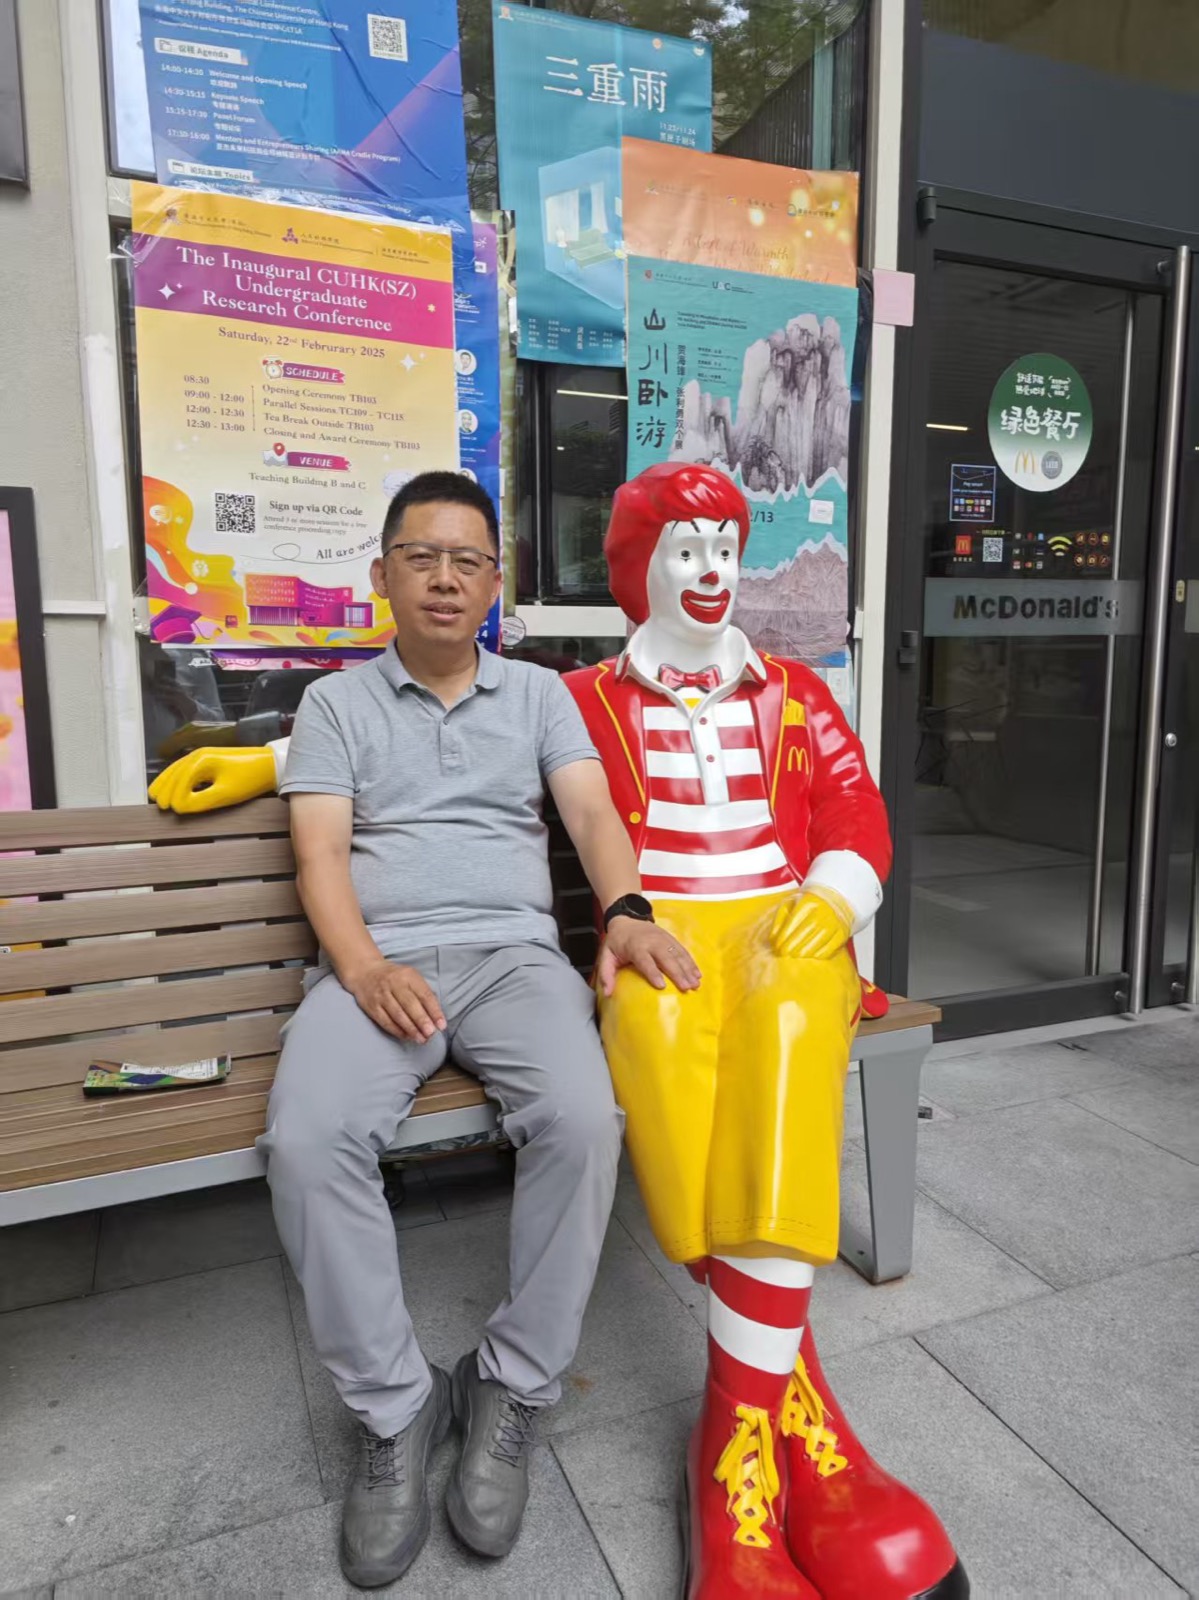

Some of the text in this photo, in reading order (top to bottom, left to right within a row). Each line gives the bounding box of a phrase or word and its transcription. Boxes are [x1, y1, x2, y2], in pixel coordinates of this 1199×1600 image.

[235, 6, 247, 14] The
[197, 47, 228, 59] Agenda
[209, 70, 240, 79] Welcome
[255, 76, 282, 88] Opening
[284, 79, 308, 90] Speech
[543, 55, 668, 113] 三重雨
[240, 96, 265, 105] Speech
[213, 112, 234, 121] Panel
[235, 115, 256, 123] Forum
[225, 171, 251, 181] Topics
[176, 245, 417, 300] The Inaugural CUHK(SZ)
[235, 274, 368, 309] Undergraduate
[202, 290, 392, 332] Research Conference
[218, 326, 273, 346] Saturday,
[360, 345, 386, 358] 2025
[184, 374, 210, 385] 08:30
[285, 366, 339, 381] SCHEDULE
[636, 308, 668, 448] 山川卧游
[184, 389, 210, 399] 09:00
[220, 393, 245, 403] 12:00
[262, 384, 377, 405] Opening Ceremony TB103
[186, 404, 211, 414] 12:00
[220, 408, 245, 418] 12:30
[263, 397, 297, 410] Parallel
[300, 403, 337, 414] Sessions
[186, 419, 211, 429] 12:30
[220, 422, 245, 432] 13:00
[264, 412, 374, 432] Tea Break Outside TB103
[1000, 405, 1081, 441] 绿色餐厅
[263, 427, 421, 451] Closing and Award Ceremony TB103
[300, 456, 334, 468] VENUE
[249, 472, 289, 485] Teaching
[292, 475, 328, 488] Building
[330, 480, 338, 488] B
[340, 481, 356, 489] and
[269, 500, 363, 516] Sign up via QR Code
[750, 510, 774, 523] /13
[316, 549, 332, 559] All
[336, 547, 354, 557] are
[953, 595, 1119, 620] McDonald's
